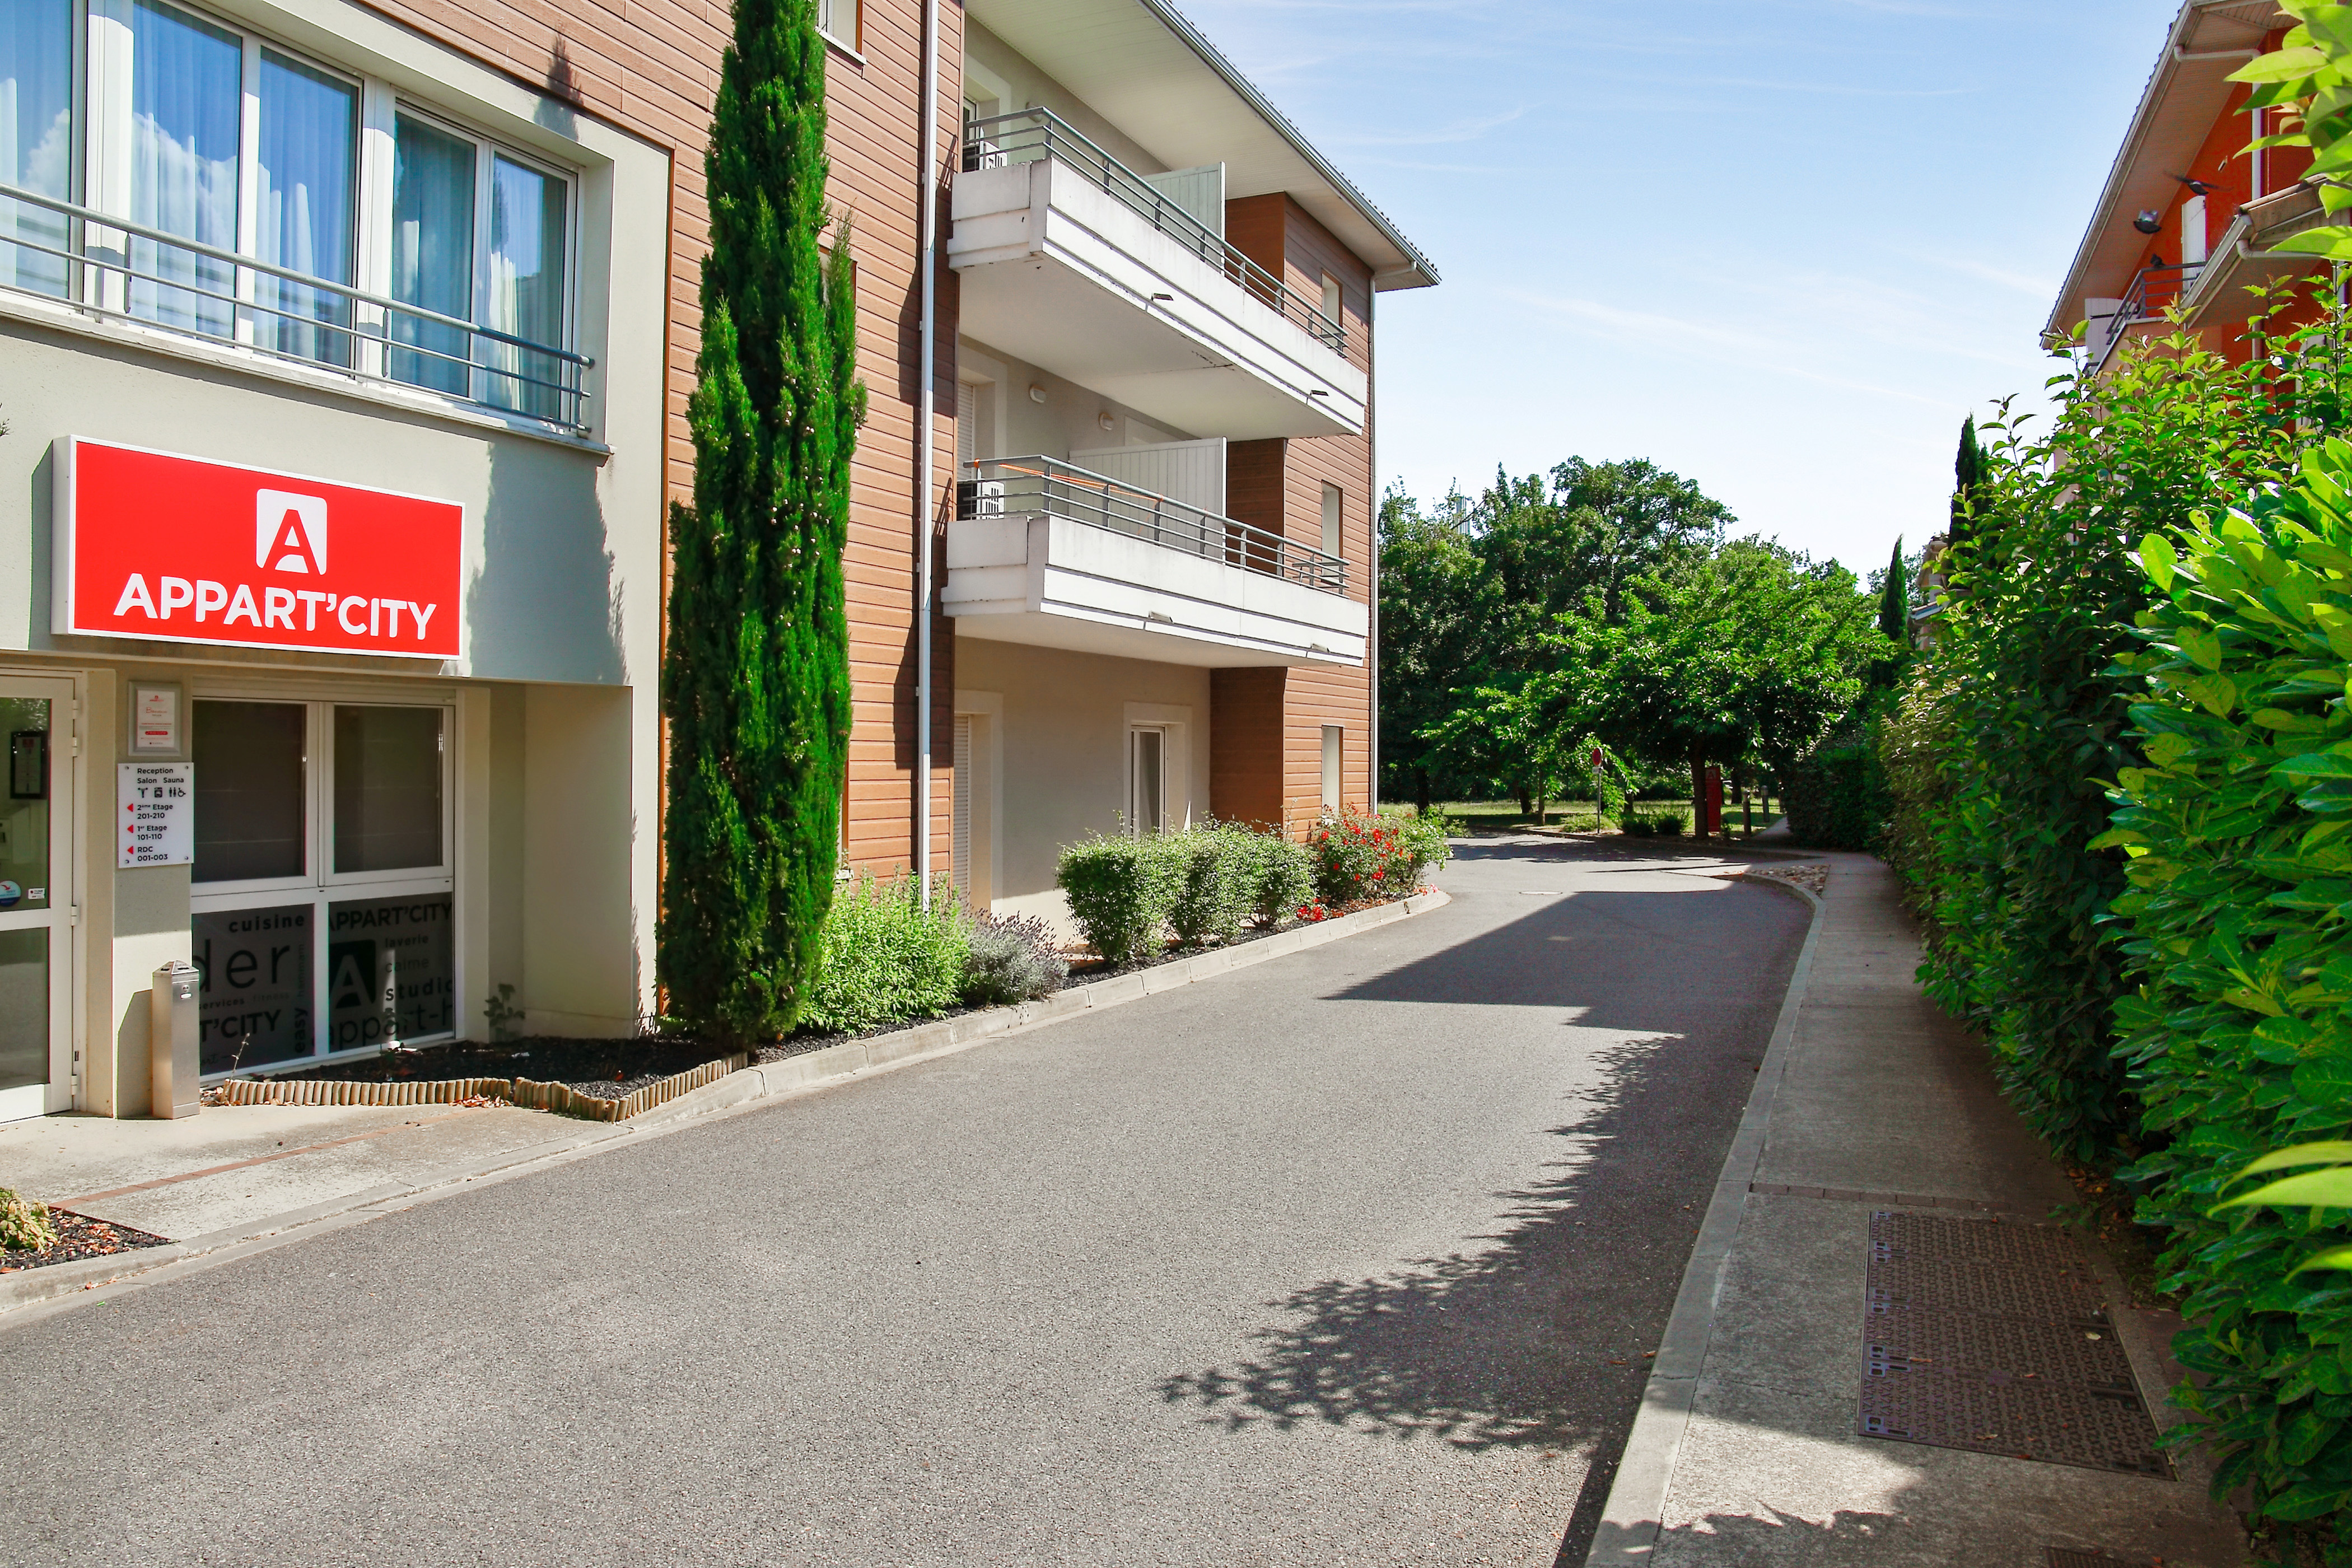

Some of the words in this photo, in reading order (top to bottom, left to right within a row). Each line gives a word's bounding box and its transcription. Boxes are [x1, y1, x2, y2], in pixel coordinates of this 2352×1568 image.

[262, 507, 323, 576] A
[113, 572, 437, 640] APPART'CITY
[228, 914, 305, 932] cuisine
[385, 934, 429, 948] laverie
[385, 957, 429, 973] calme
[200, 1009, 281, 1042] T'CITY
[295, 1007, 308, 1053] easy
